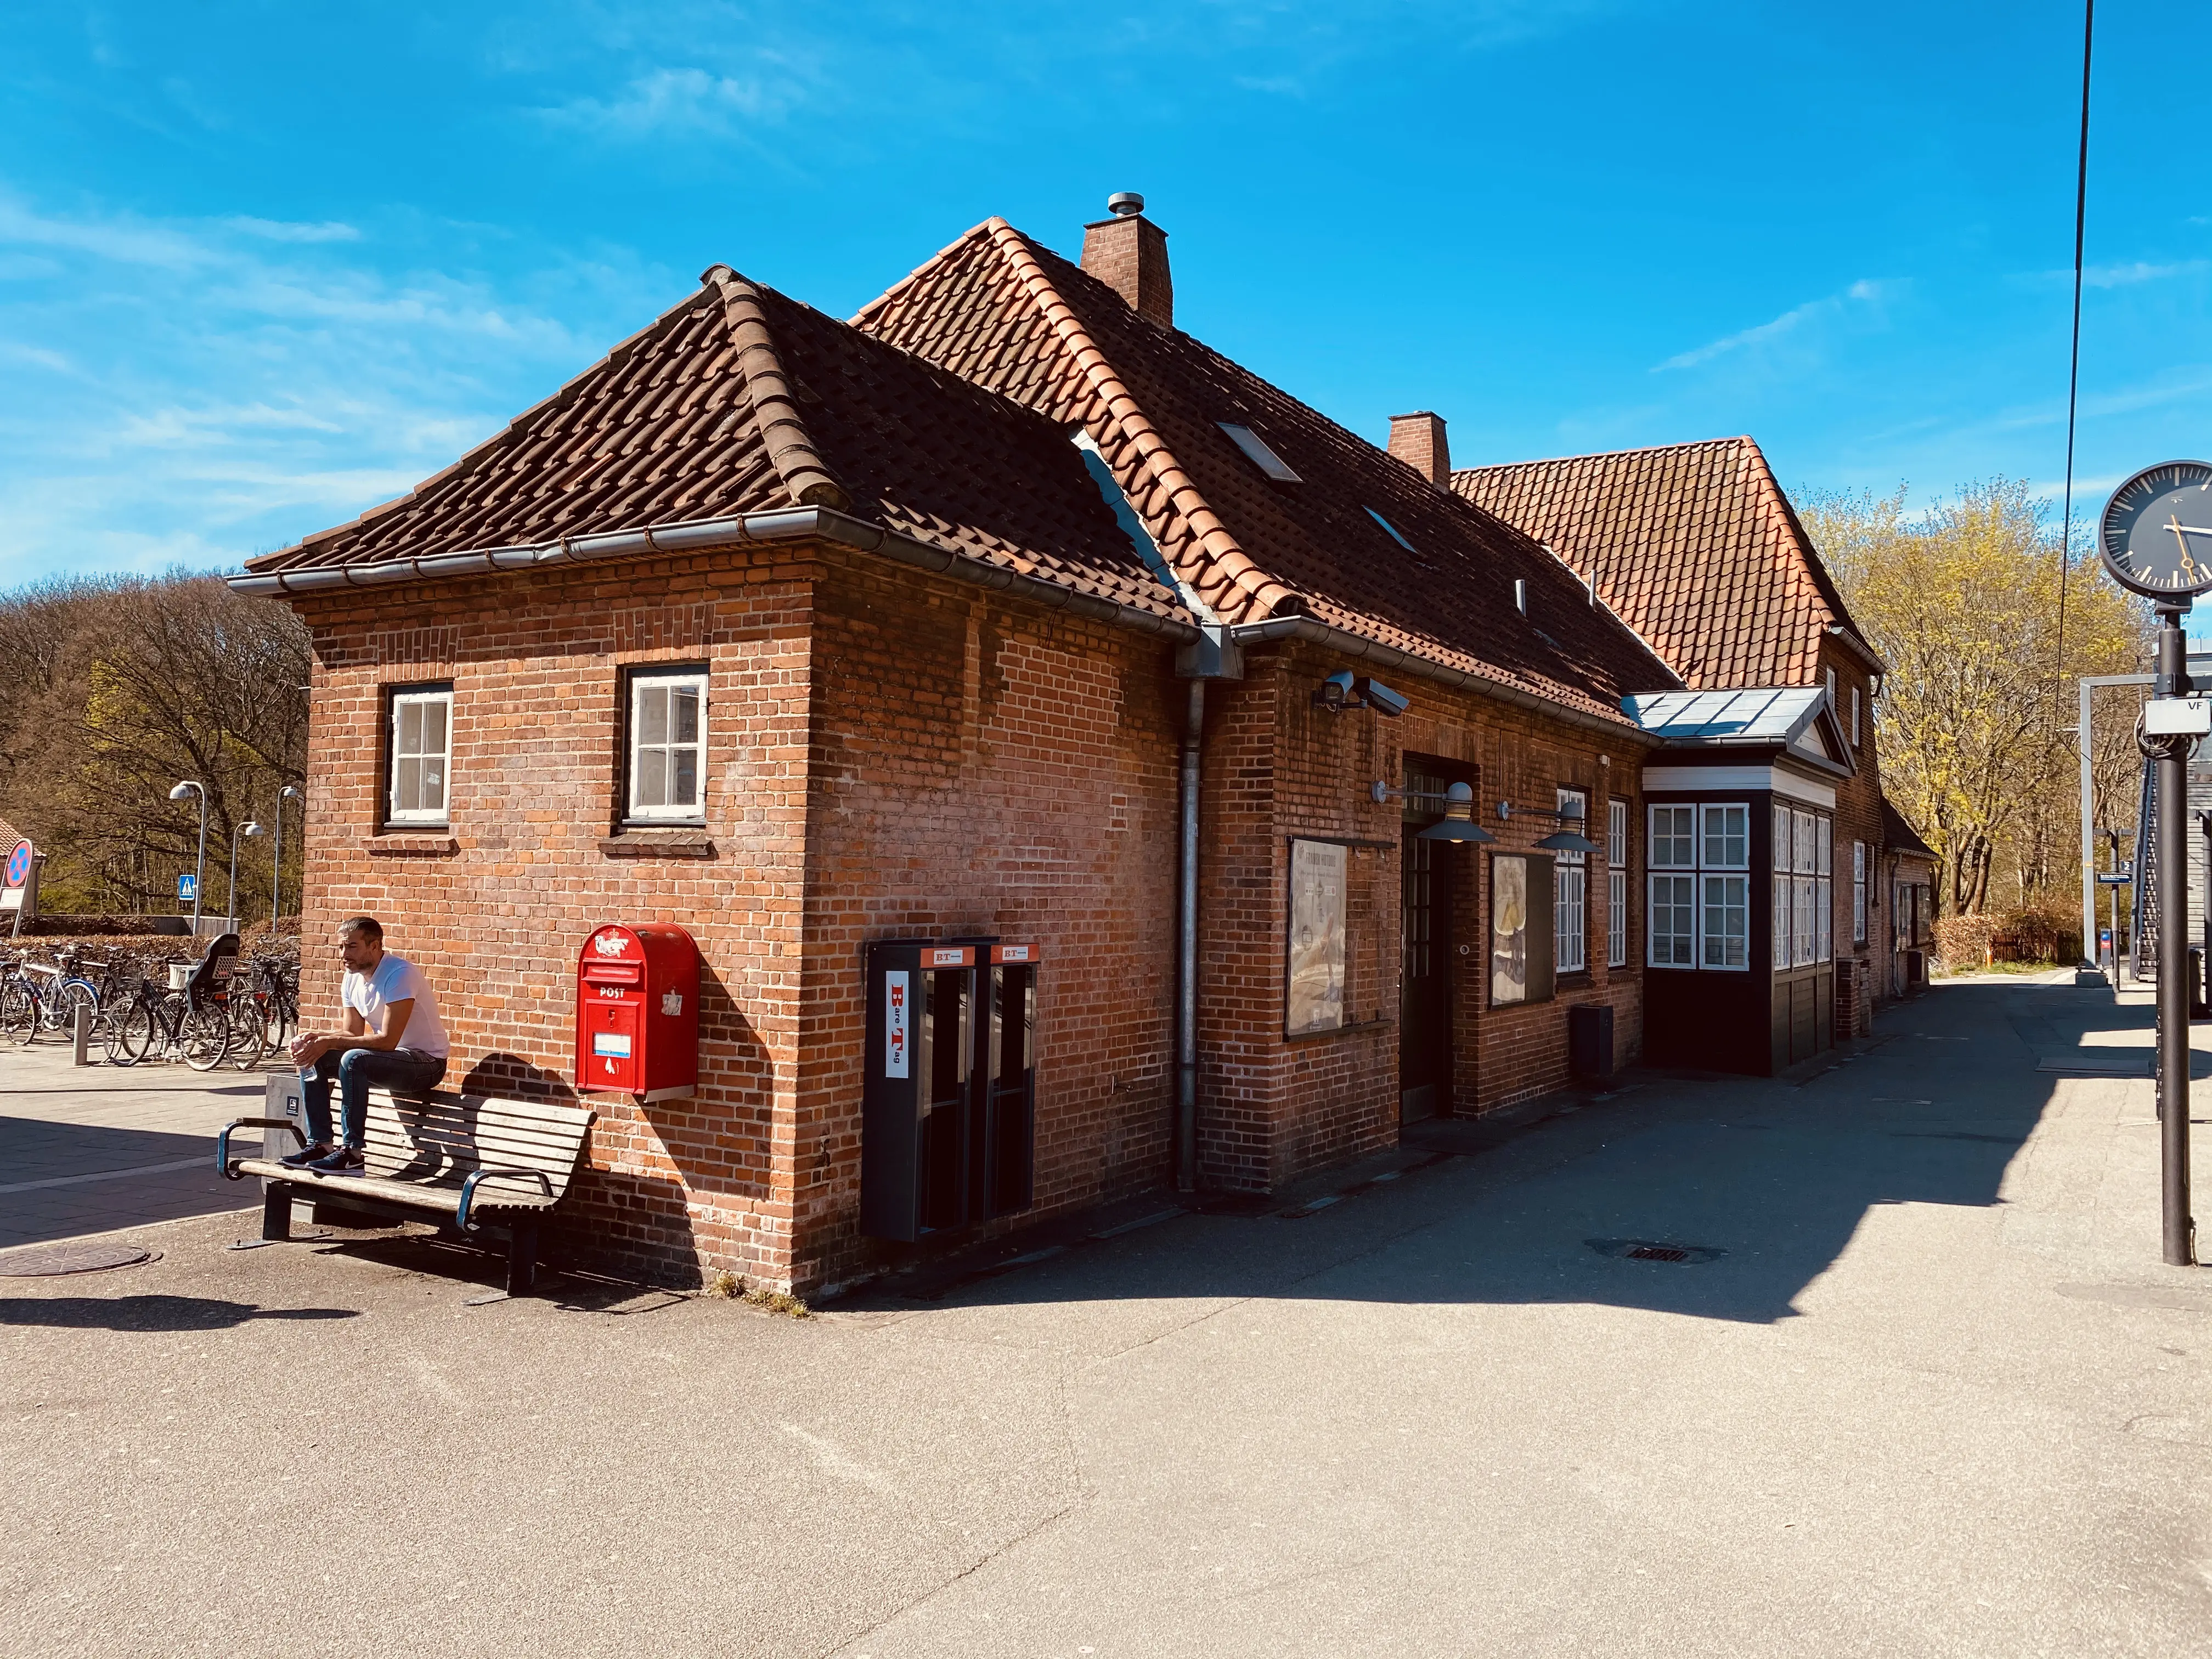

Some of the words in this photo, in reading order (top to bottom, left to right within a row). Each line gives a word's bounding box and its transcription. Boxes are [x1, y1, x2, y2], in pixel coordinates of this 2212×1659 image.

[2188, 702, 2203, 710] VF
[600, 987, 625, 999] POST
[891, 984, 904, 1024] Bare
[891, 1028, 904, 1064] Tag
